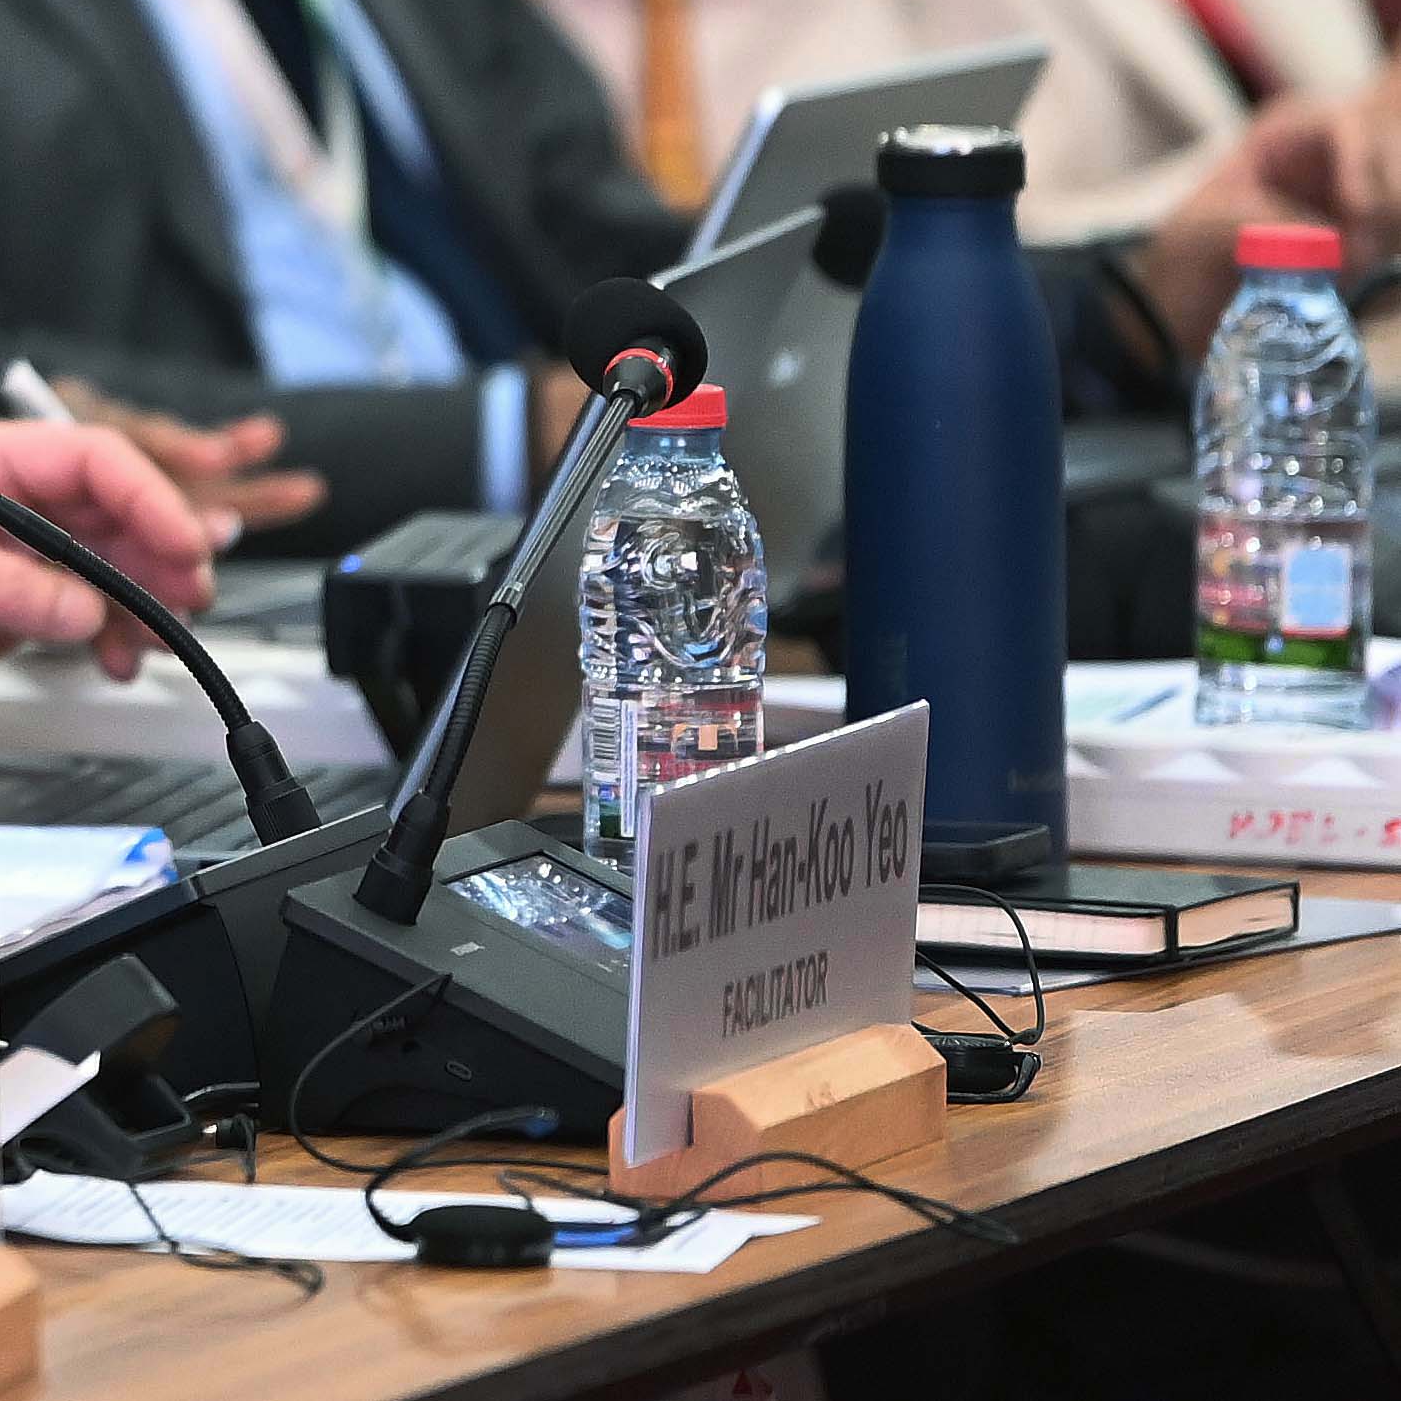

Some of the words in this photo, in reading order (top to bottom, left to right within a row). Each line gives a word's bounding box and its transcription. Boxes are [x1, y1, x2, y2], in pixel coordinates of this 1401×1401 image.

[709, 828, 744, 941] Mr
[748, 797, 855, 928] Han-Koo
[865, 779, 908, 888] Yeo
[722, 951, 829, 1038] FACILITATOR
